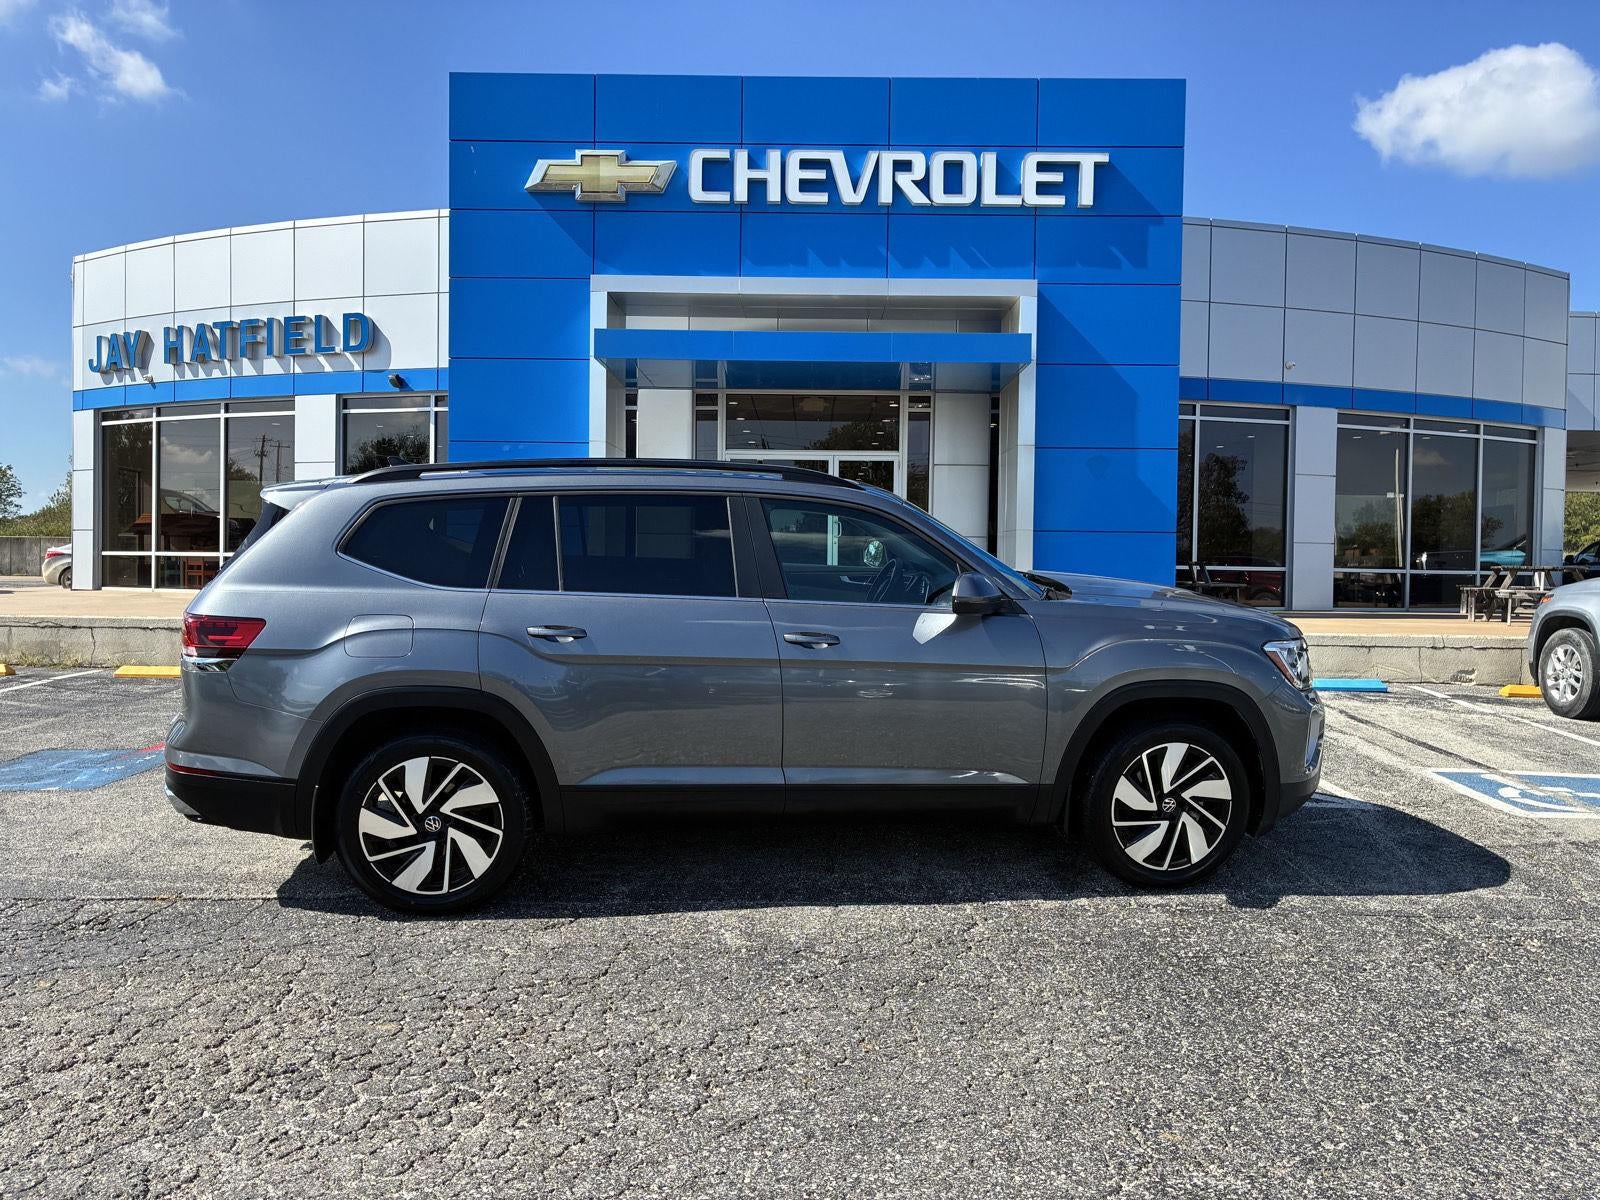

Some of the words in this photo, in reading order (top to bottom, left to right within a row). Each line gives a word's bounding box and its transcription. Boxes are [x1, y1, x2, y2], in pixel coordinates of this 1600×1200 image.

[688, 149, 1110, 207] CHEVROLET
[88, 330, 152, 373] JAY
[163, 312, 377, 364] HATFIELD
